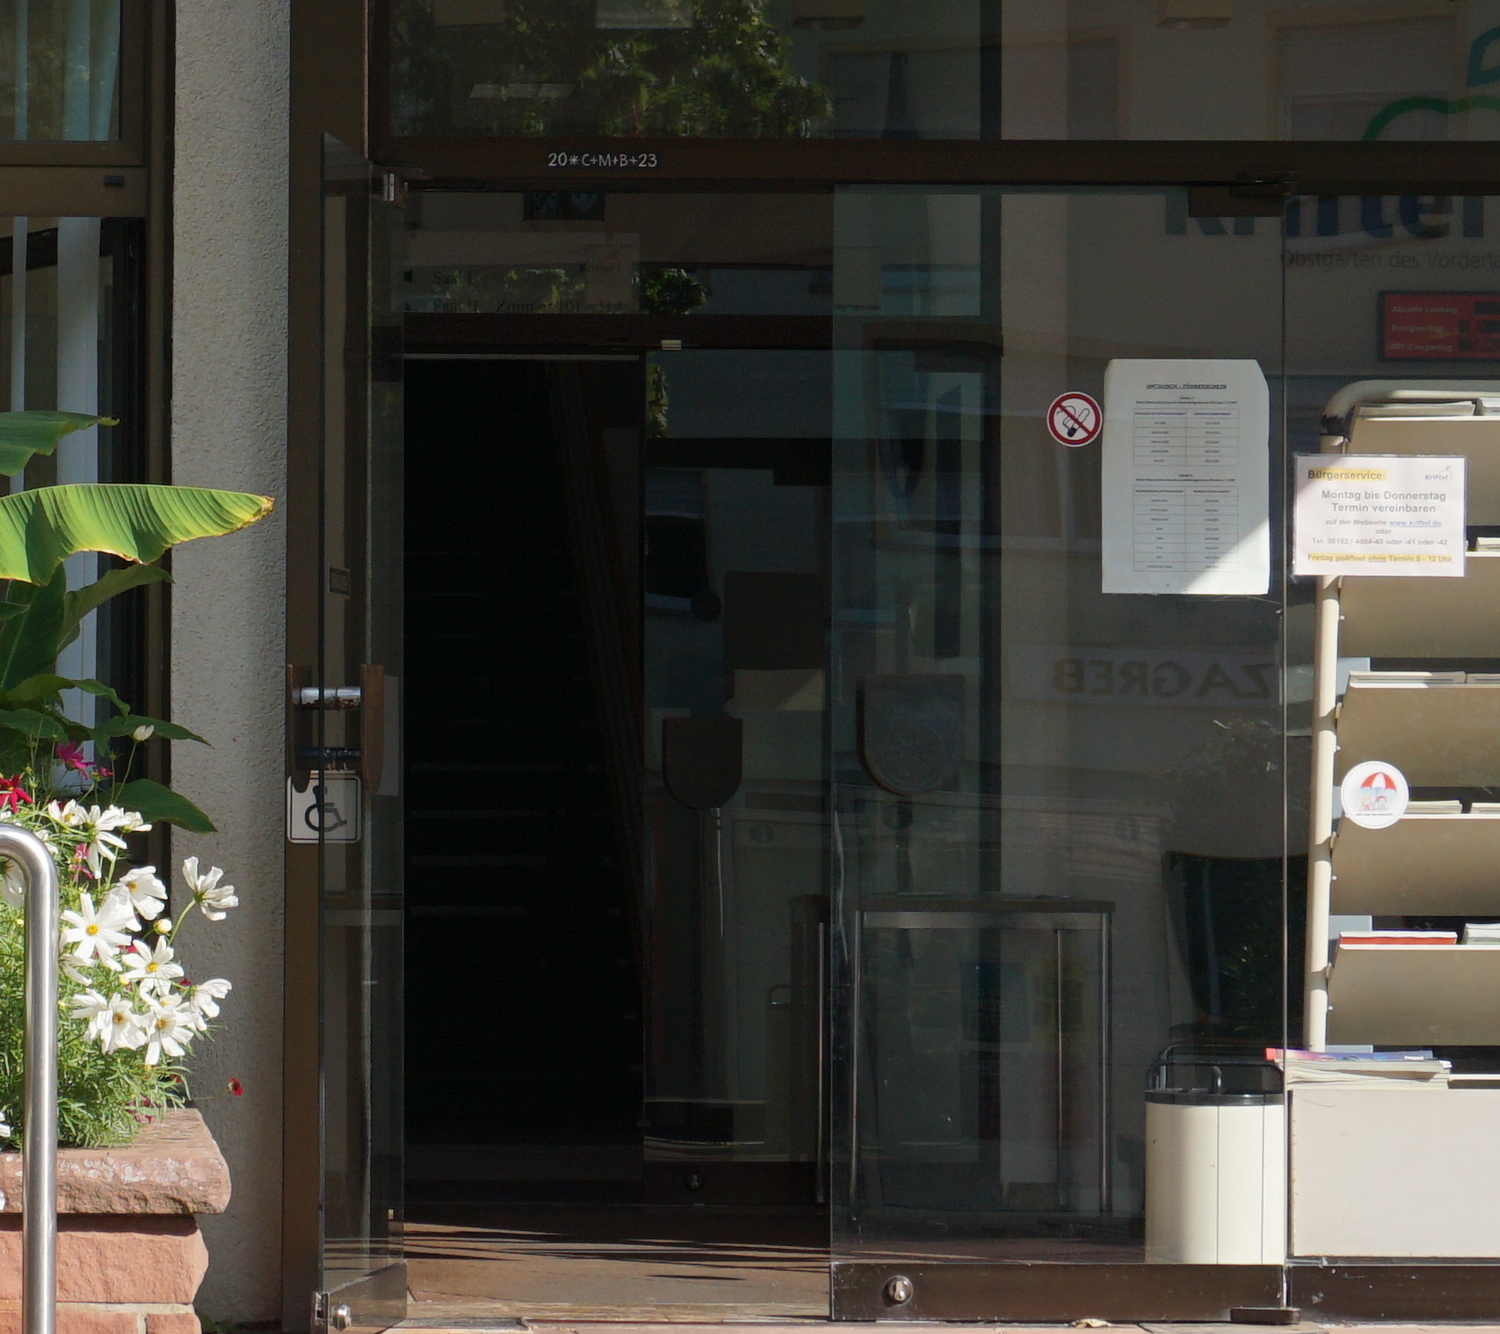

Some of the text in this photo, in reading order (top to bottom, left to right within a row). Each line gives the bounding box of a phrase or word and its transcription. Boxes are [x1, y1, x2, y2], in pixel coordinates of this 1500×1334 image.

[1282, 251, 1382, 269] Obstgarten
[1389, 251, 1419, 267] des
[1308, 470, 1386, 480] Bürgerservice:
[1322, 490, 1446, 502] Montag bis Donnerstag
[1332, 503, 1436, 513] Termin vereinbaren
